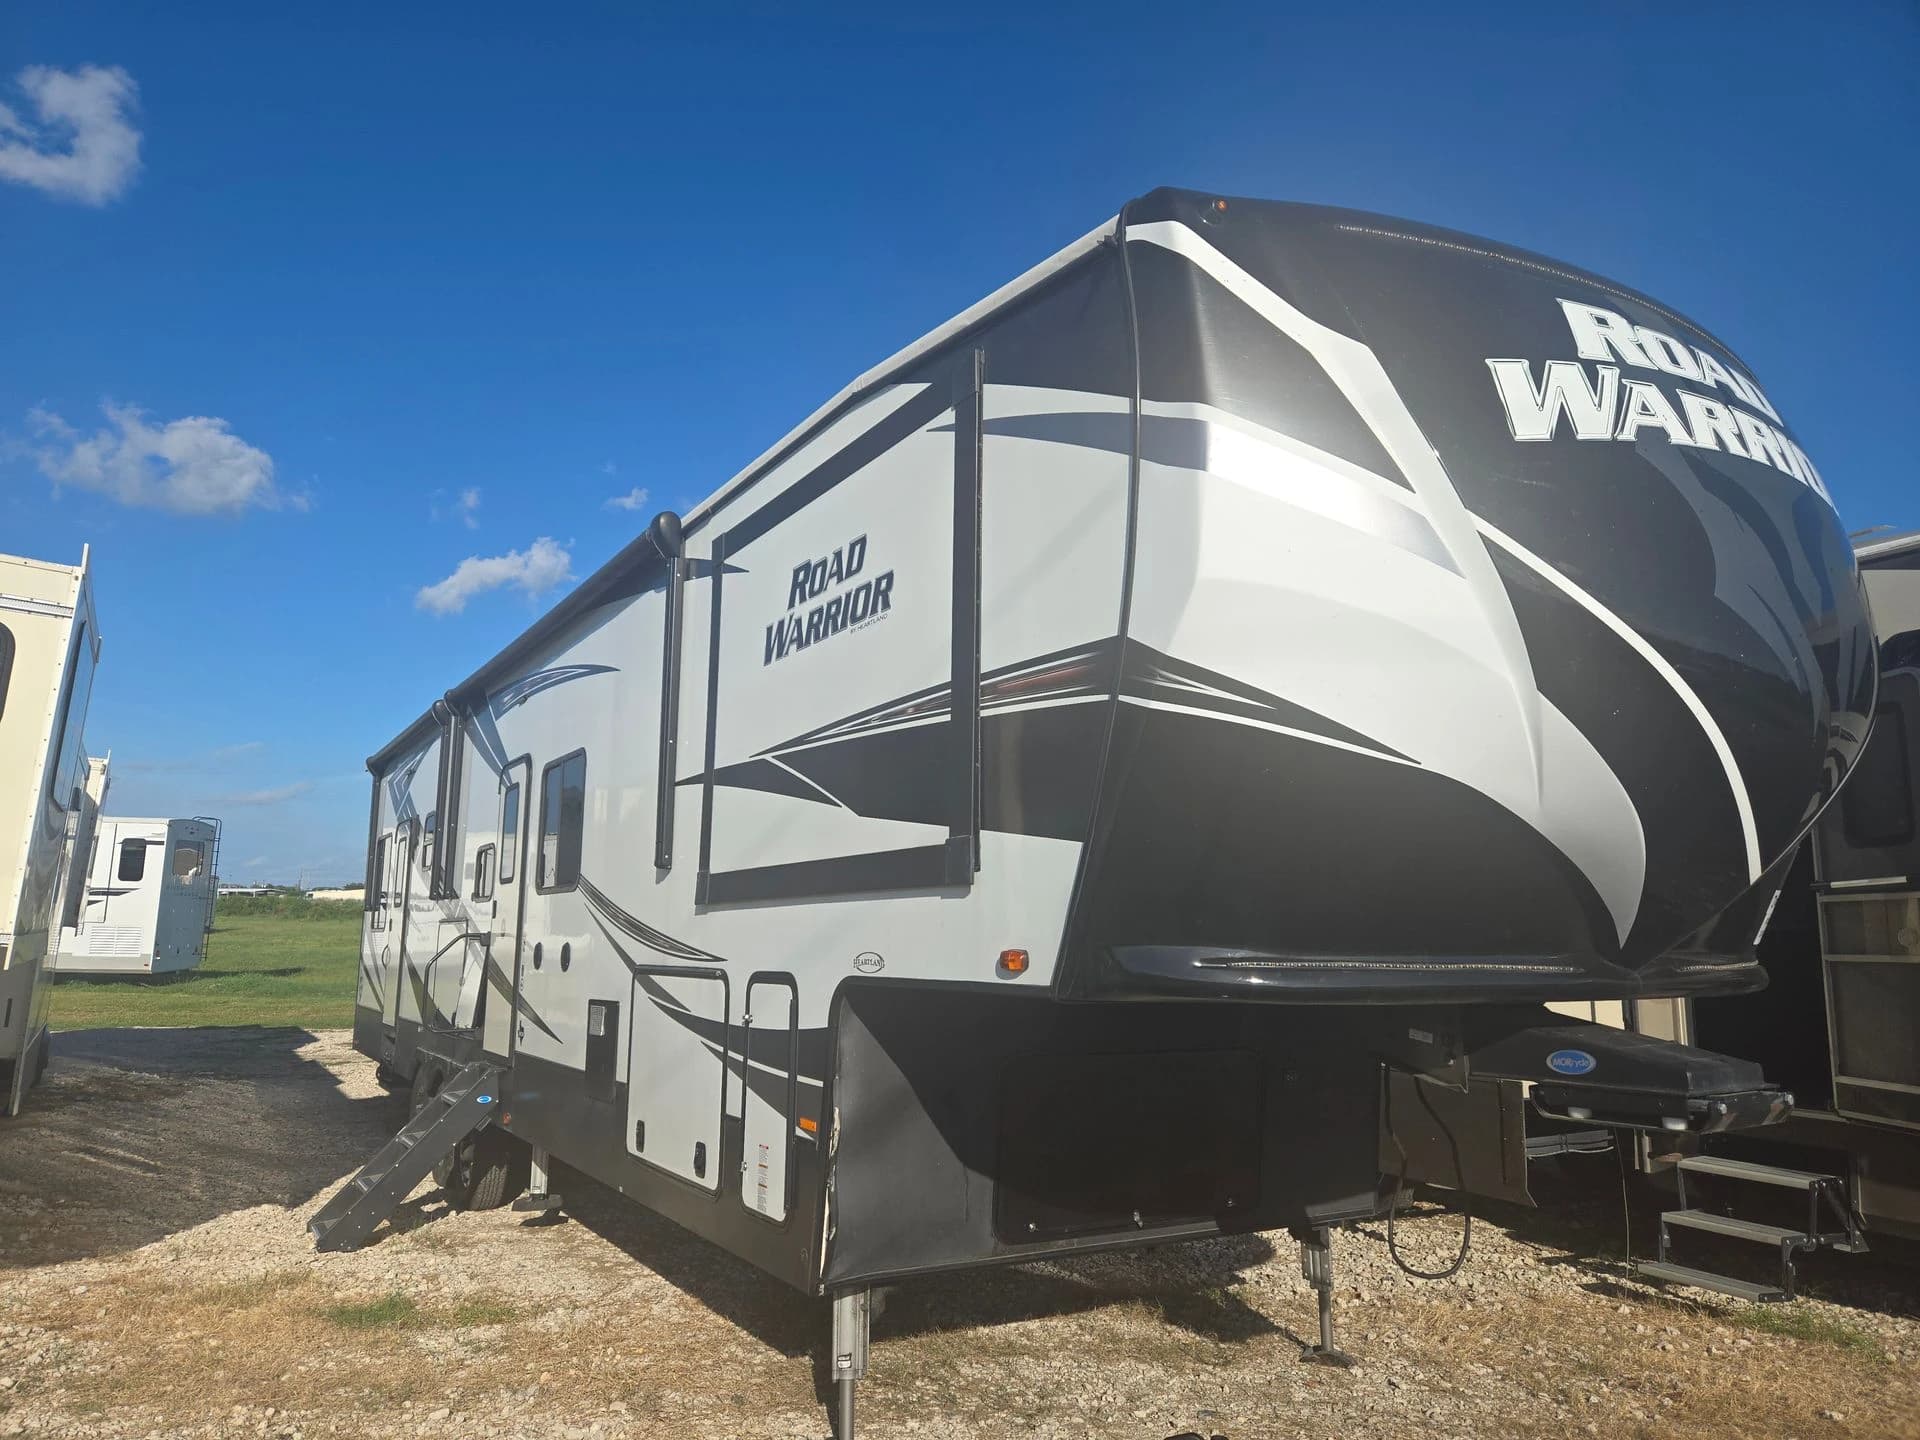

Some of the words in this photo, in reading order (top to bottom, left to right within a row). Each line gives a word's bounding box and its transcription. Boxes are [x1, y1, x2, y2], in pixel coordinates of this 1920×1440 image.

[1556, 297, 1784, 427] ROAD
[1485, 358, 1840, 517] WARRIO
[787, 533, 867, 611] ROAD
[763, 569, 894, 667] WARRIOR
[857, 613, 888, 630] HEARTLAND
[853, 958, 885, 968] HEARTLAND
